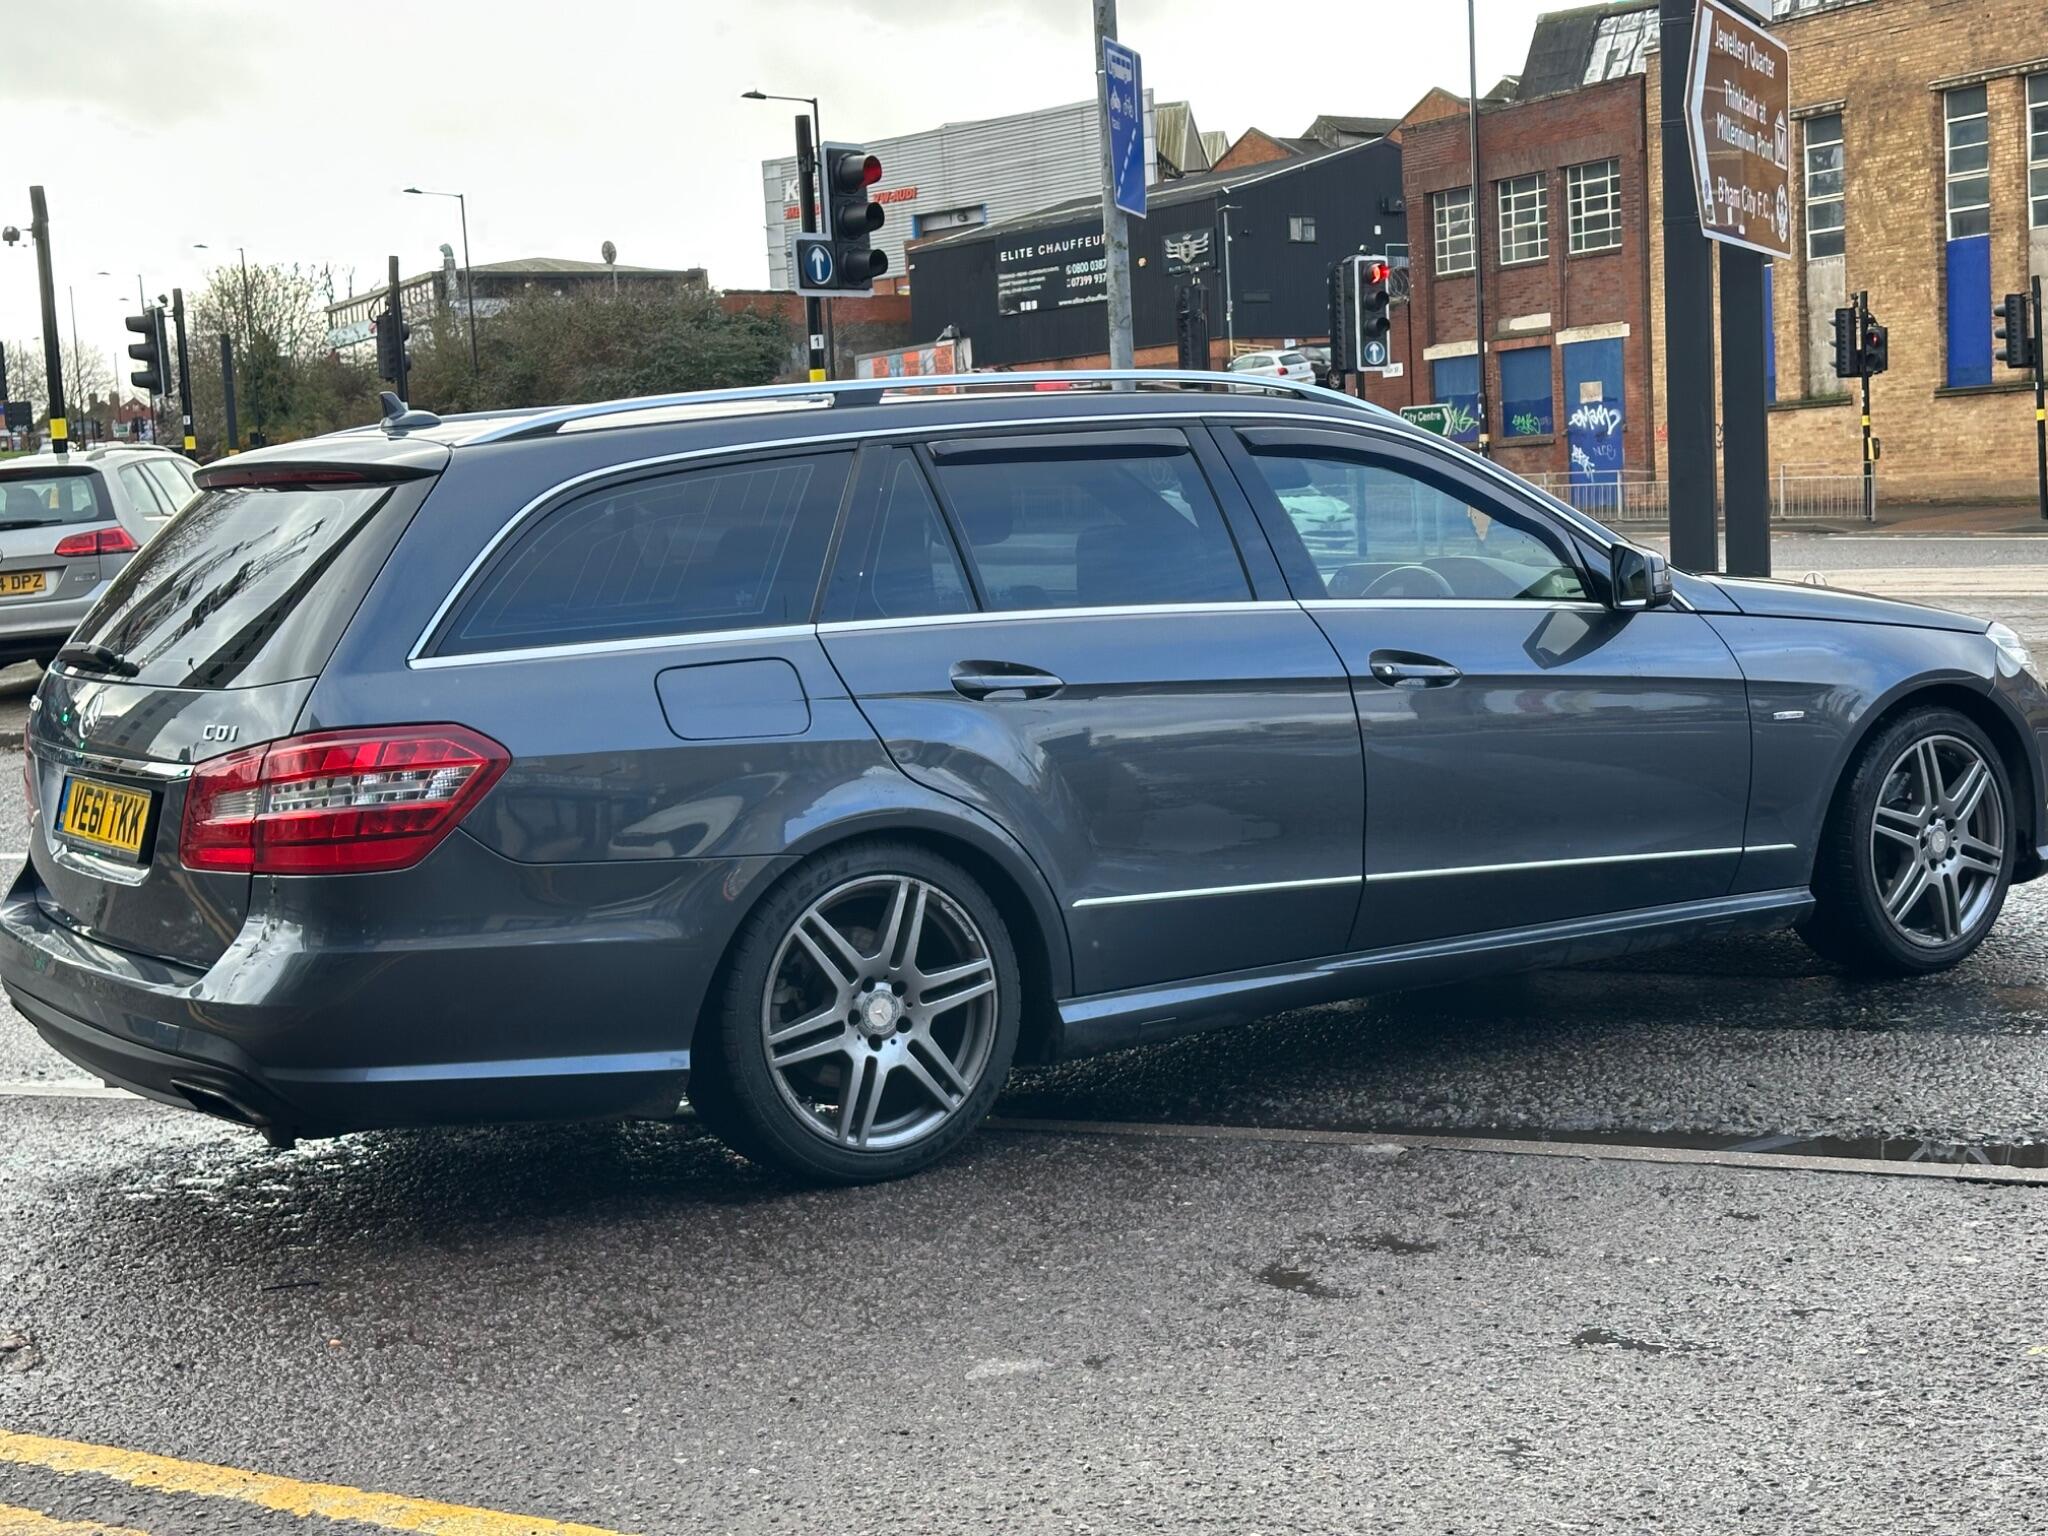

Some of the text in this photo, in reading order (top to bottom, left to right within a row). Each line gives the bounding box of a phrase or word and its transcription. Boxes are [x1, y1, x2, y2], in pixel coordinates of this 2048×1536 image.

[1715, 20, 1775, 79] Jewellery Quarter
[1724, 79, 1767, 124] Thinktank at
[1716, 112, 1774, 162] Millennium Point
[1741, 185, 1756, 219] City
[1000, 247, 1033, 262] ELITE
[1072, 262, 1088, 274] 0800
[814, 336, 820, 347] 1
[1403, 411, 1441, 423] City Centre
[11, 573, 43, 591] DPZ
[202, 724, 239, 742] CDI
[108, 794, 145, 846] TKK
